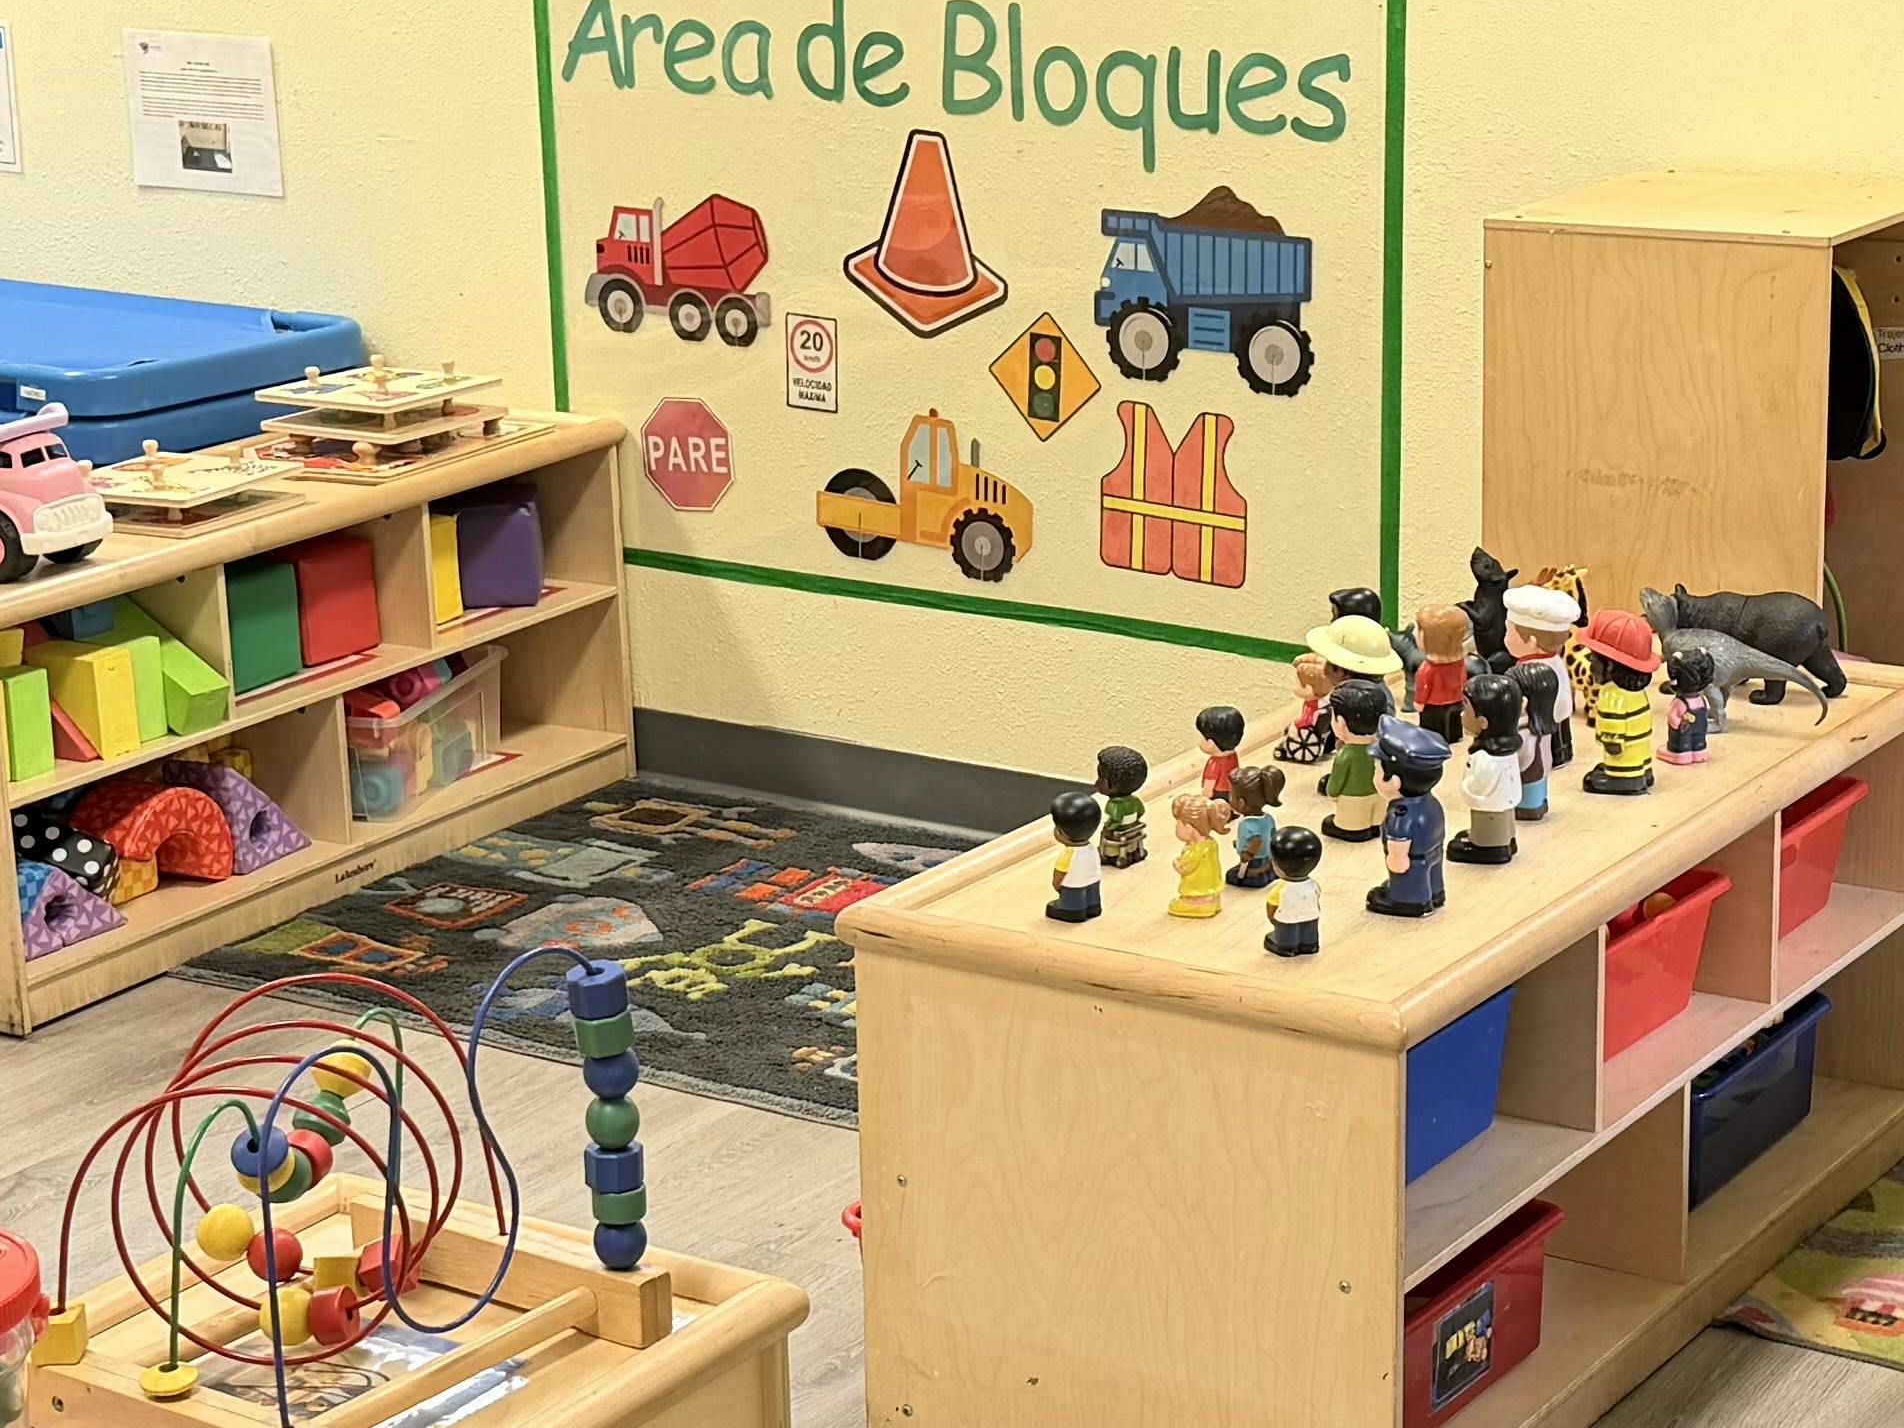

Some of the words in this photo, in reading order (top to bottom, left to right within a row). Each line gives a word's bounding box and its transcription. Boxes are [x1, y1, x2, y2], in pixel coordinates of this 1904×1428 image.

[799, 329, 824, 352] 20
[792, 377, 833, 392] VELOCIDAD
[647, 435, 729, 474] PARE
